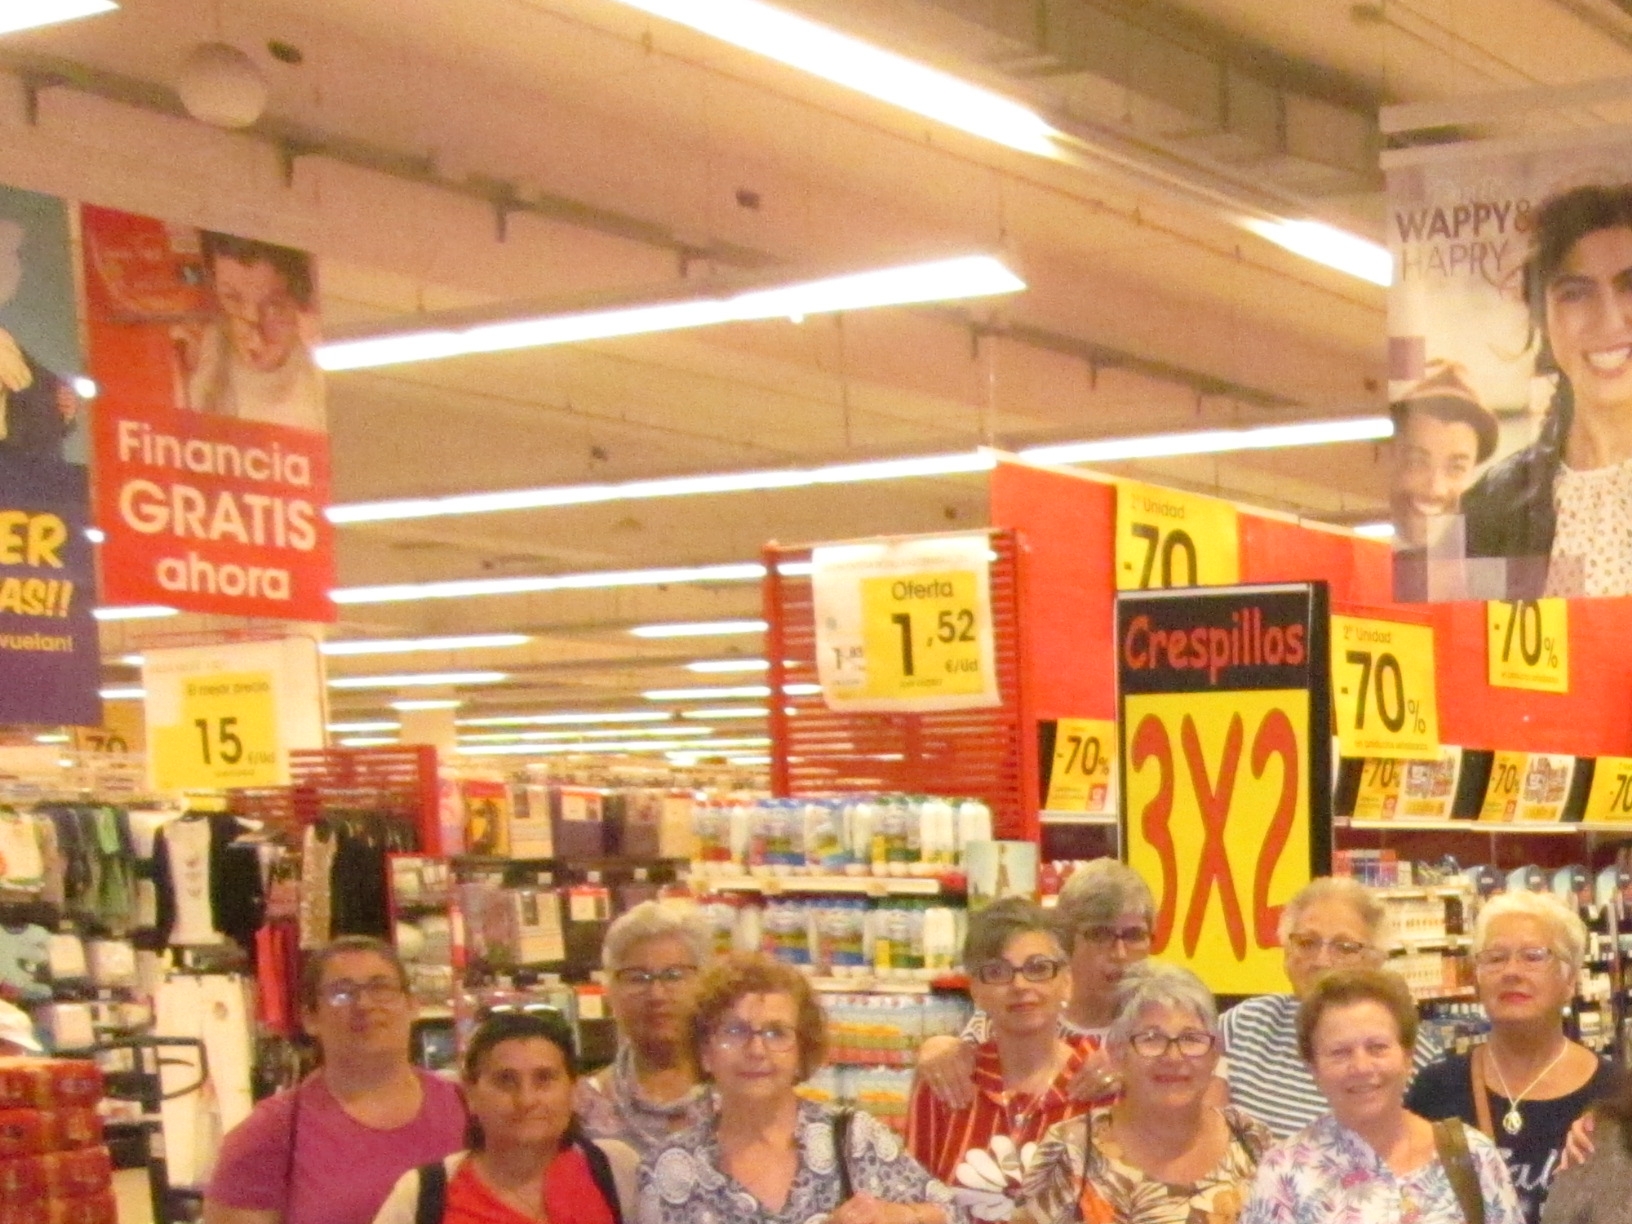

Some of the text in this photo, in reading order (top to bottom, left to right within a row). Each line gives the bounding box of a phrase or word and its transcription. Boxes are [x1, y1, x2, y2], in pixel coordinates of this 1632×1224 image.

[1396, 200, 1512, 243] WAPPY
[117, 420, 311, 487] Financia
[119, 479, 316, 550] GRATIS
[156, 552, 290, 600] ahora
[892, 580, 953, 601] Oferta
[1124, 607, 1304, 685] Crespillos
[1356, 626, 1392, 643] Unidad
[194, 716, 243, 765] 15
[1131, 707, 1299, 962] 3X2
